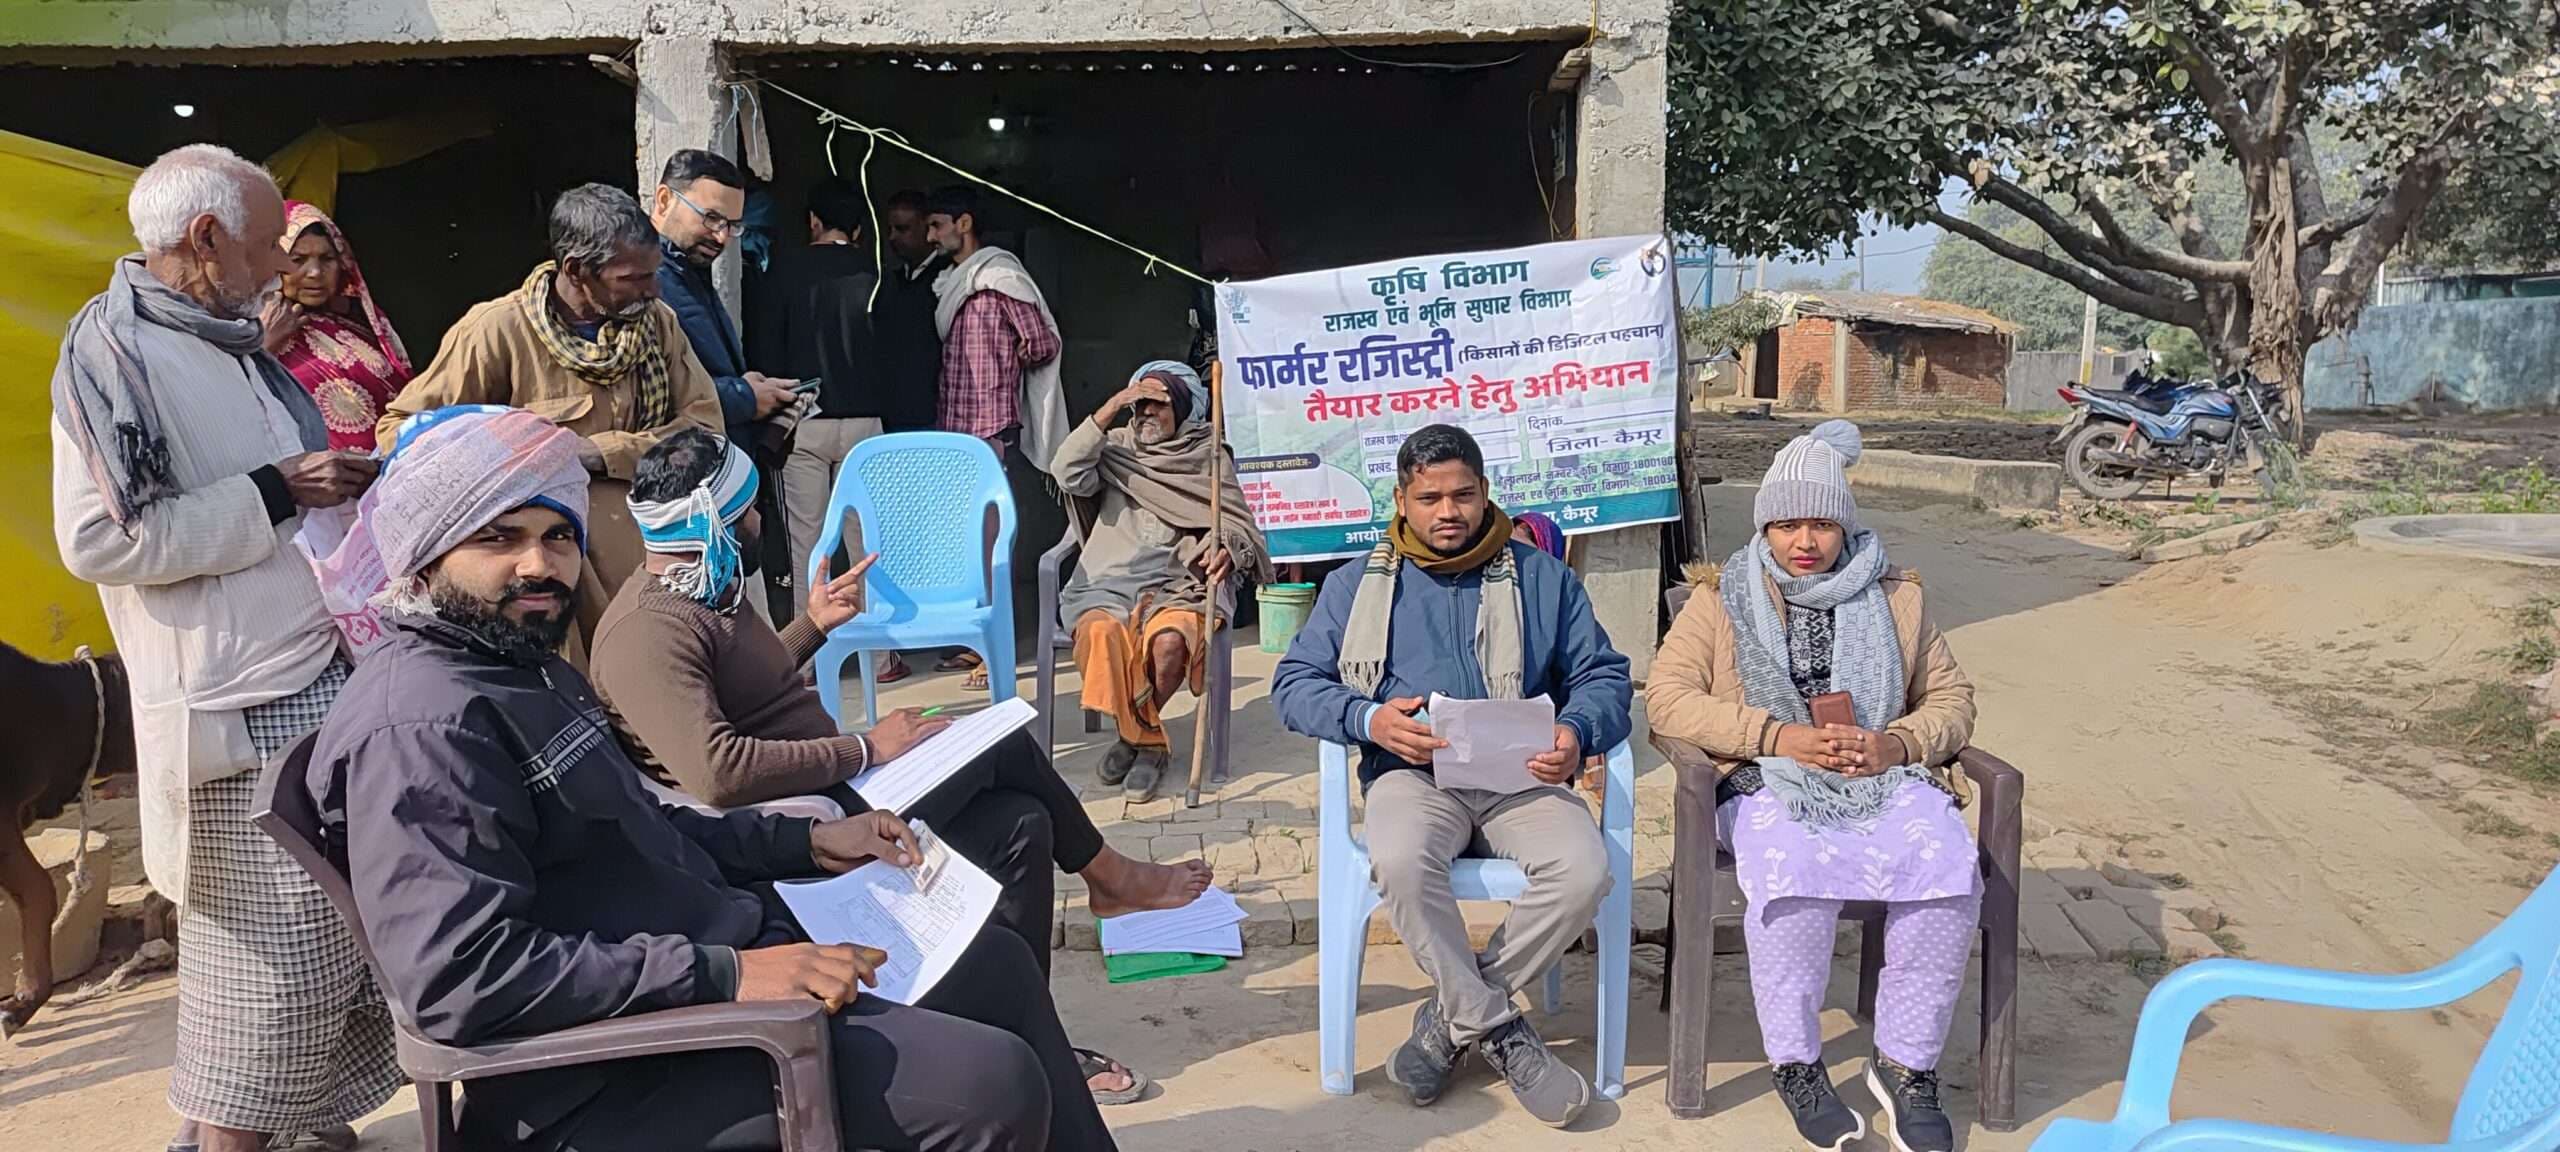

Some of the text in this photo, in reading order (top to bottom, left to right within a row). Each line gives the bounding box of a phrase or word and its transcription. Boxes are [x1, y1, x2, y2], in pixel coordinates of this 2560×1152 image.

[1368, 260, 1529, 305] कृषि विभाग
[1323, 310, 1378, 332] राजस्व
[1385, 300, 1409, 325] एवं
[1419, 297, 1456, 328] भूमि
[1519, 288, 1572, 312] विभाग
[1237, 324, 1664, 390] फार्मर रजिस्ट्री (किसानों की डिजिटल पहचान)
[1303, 360, 1651, 422] तैयार करने हेतु अभियान
[1613, 428, 1664, 446] कैमूर
[1367, 459, 1392, 475] प्रखंड
[1561, 504, 1599, 523] कैमूर
